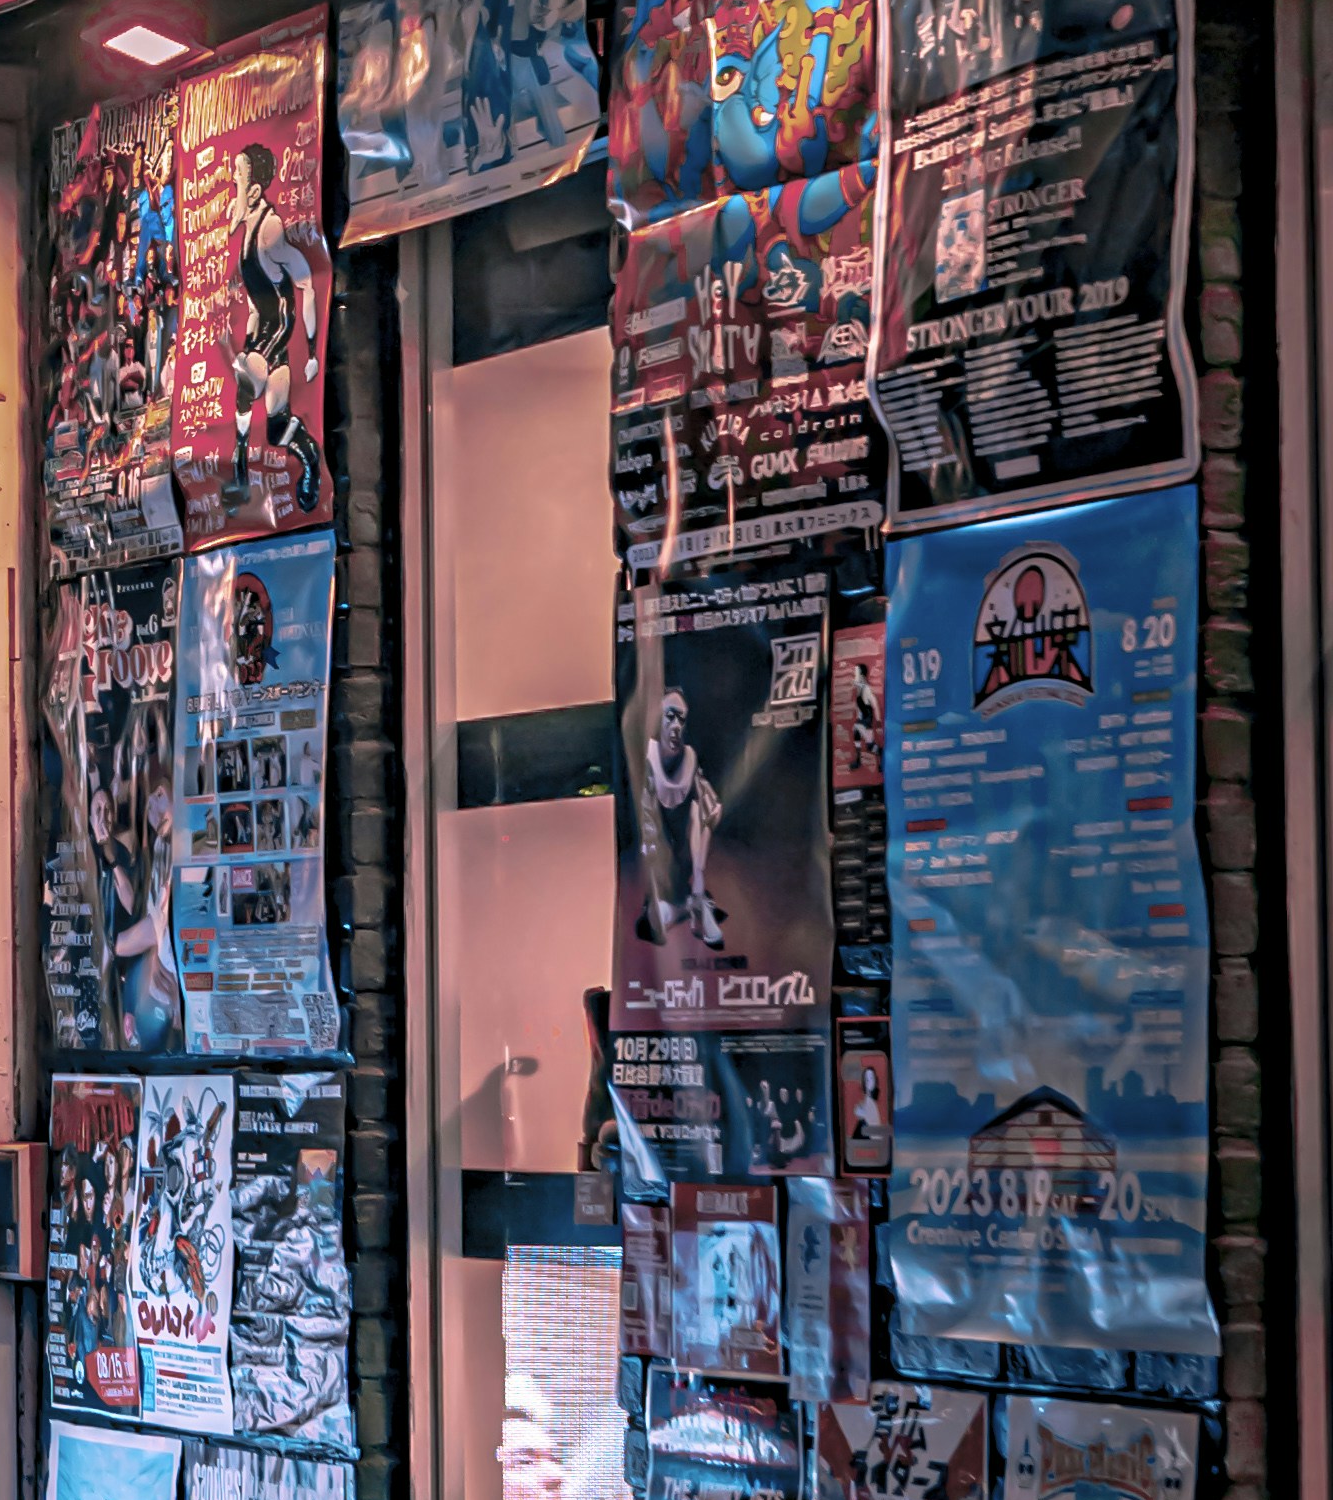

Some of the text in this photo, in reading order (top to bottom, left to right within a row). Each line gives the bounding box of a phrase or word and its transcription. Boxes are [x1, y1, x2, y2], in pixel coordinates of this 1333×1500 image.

[986, 179, 1088, 221] STRONGER
[906, 303, 1007, 352] STRONGER
[1008, 286, 1075, 329] TOUR
[1120, 612, 1177, 654] 8.20
[901, 647, 942, 685] 8.19
[908, 1168, 993, 1218] 2023
[1098, 1172, 1142, 1222] 20
